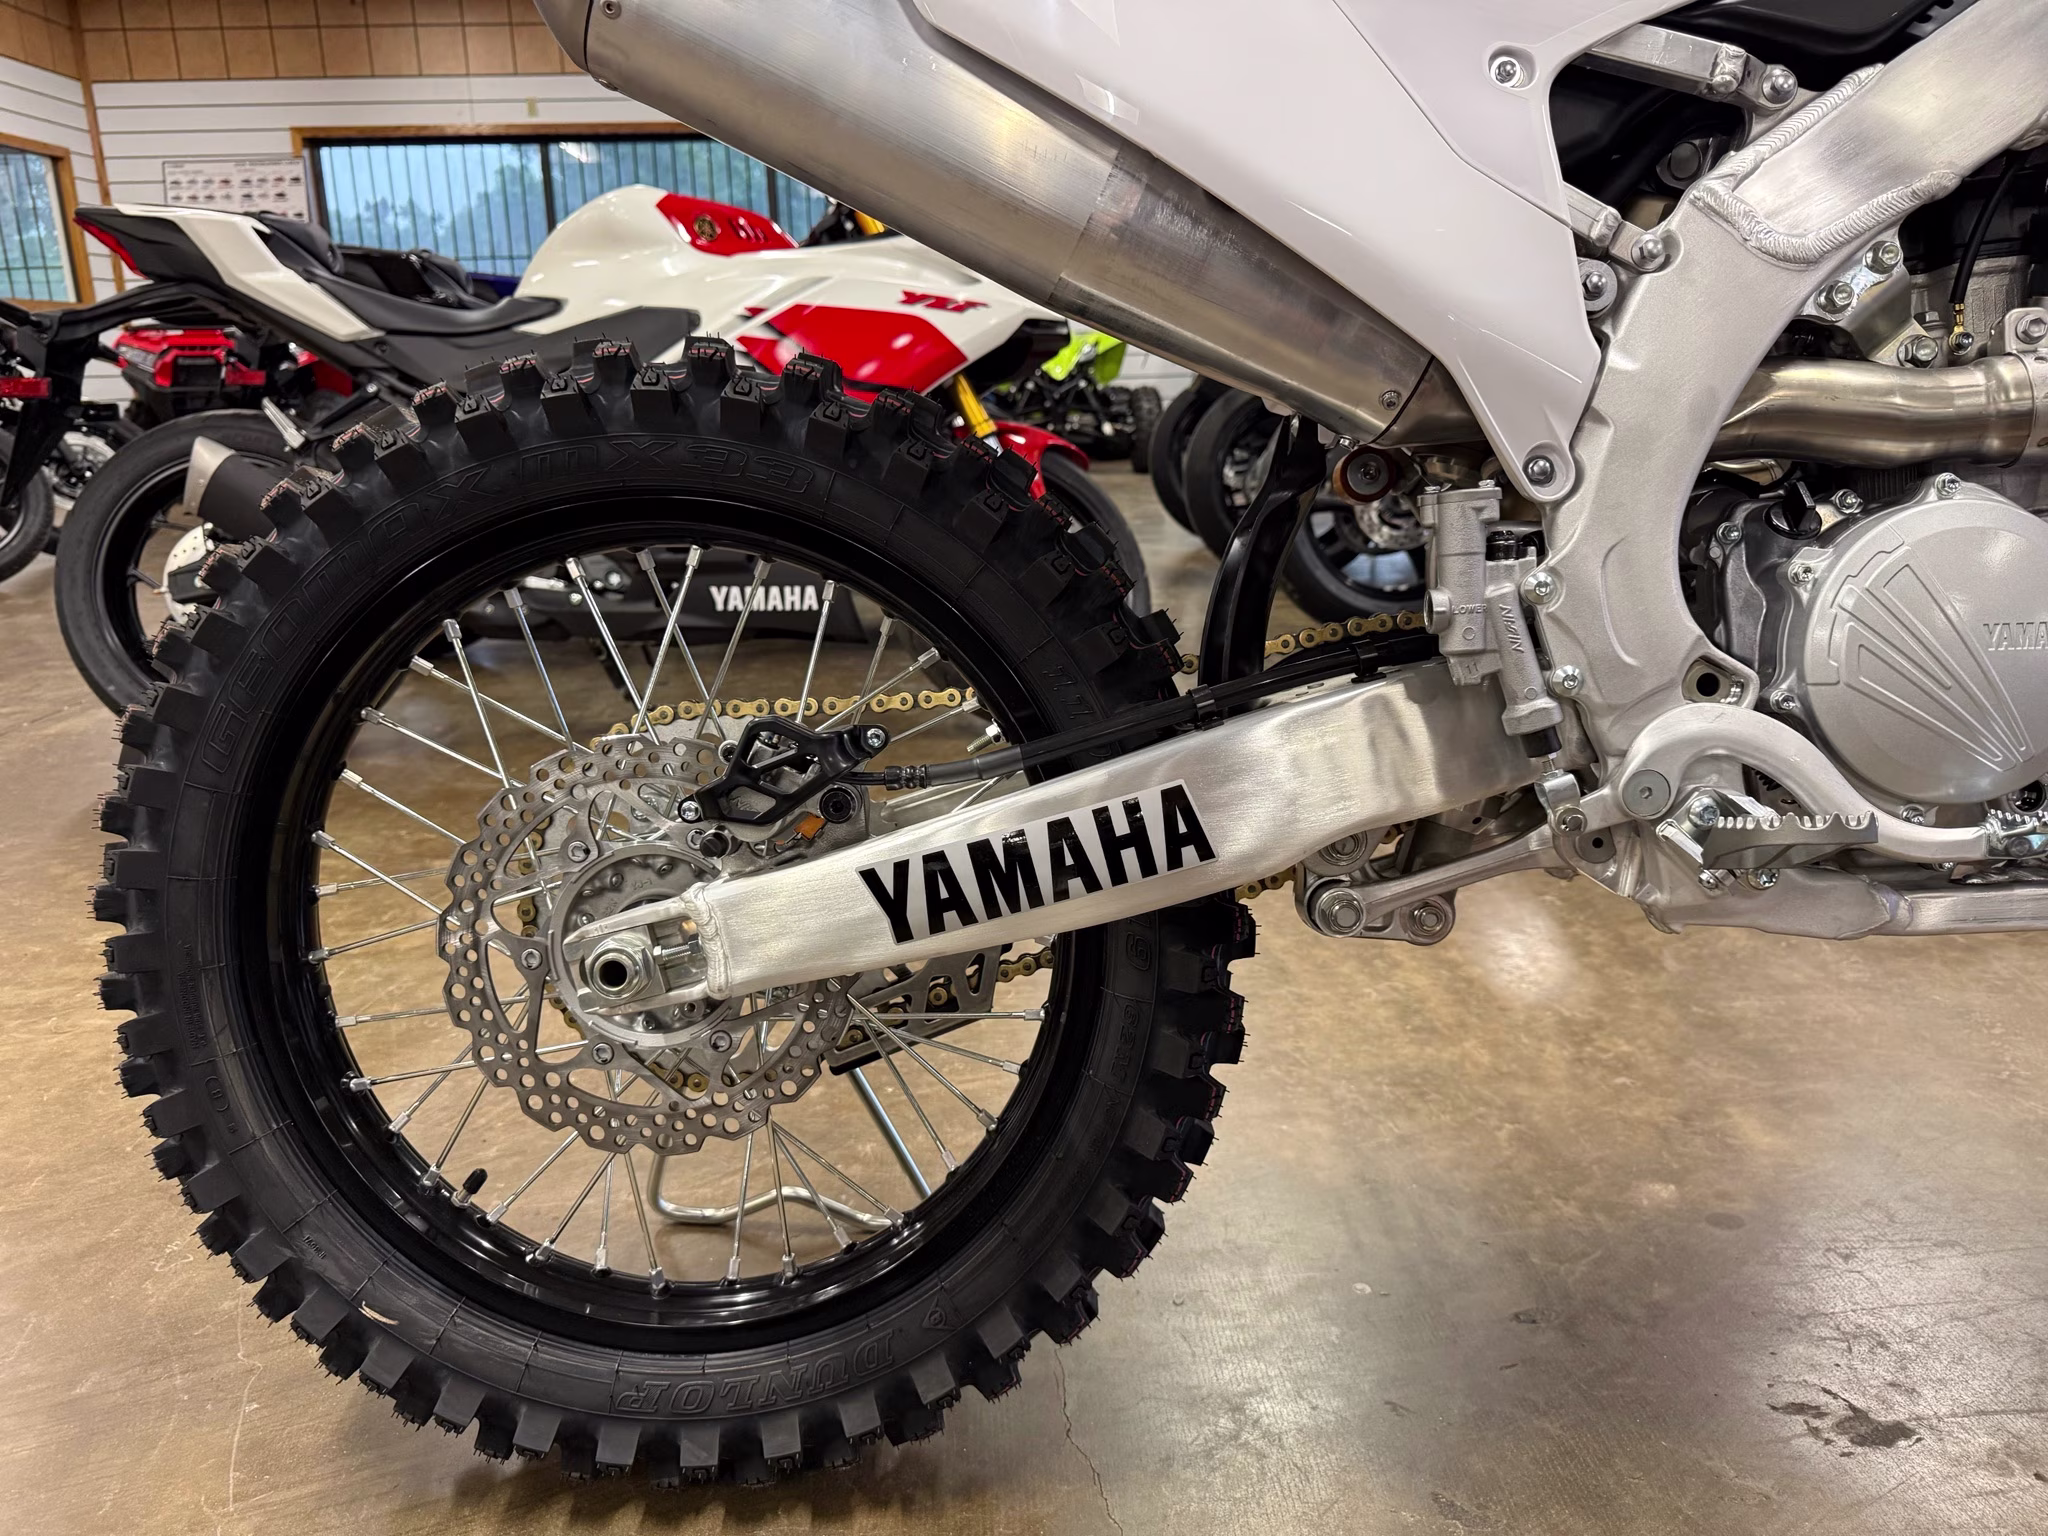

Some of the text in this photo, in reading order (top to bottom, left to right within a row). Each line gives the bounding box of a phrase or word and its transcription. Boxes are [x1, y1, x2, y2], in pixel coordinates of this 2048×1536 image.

[708, 585, 820, 612] YAMAHA
[1451, 603, 1488, 615] LOWER
[1499, 603, 1525, 654] NISSIN
[857, 783, 1217, 944] YAMAHA
[613, 1328, 896, 1415] DUNLOP
